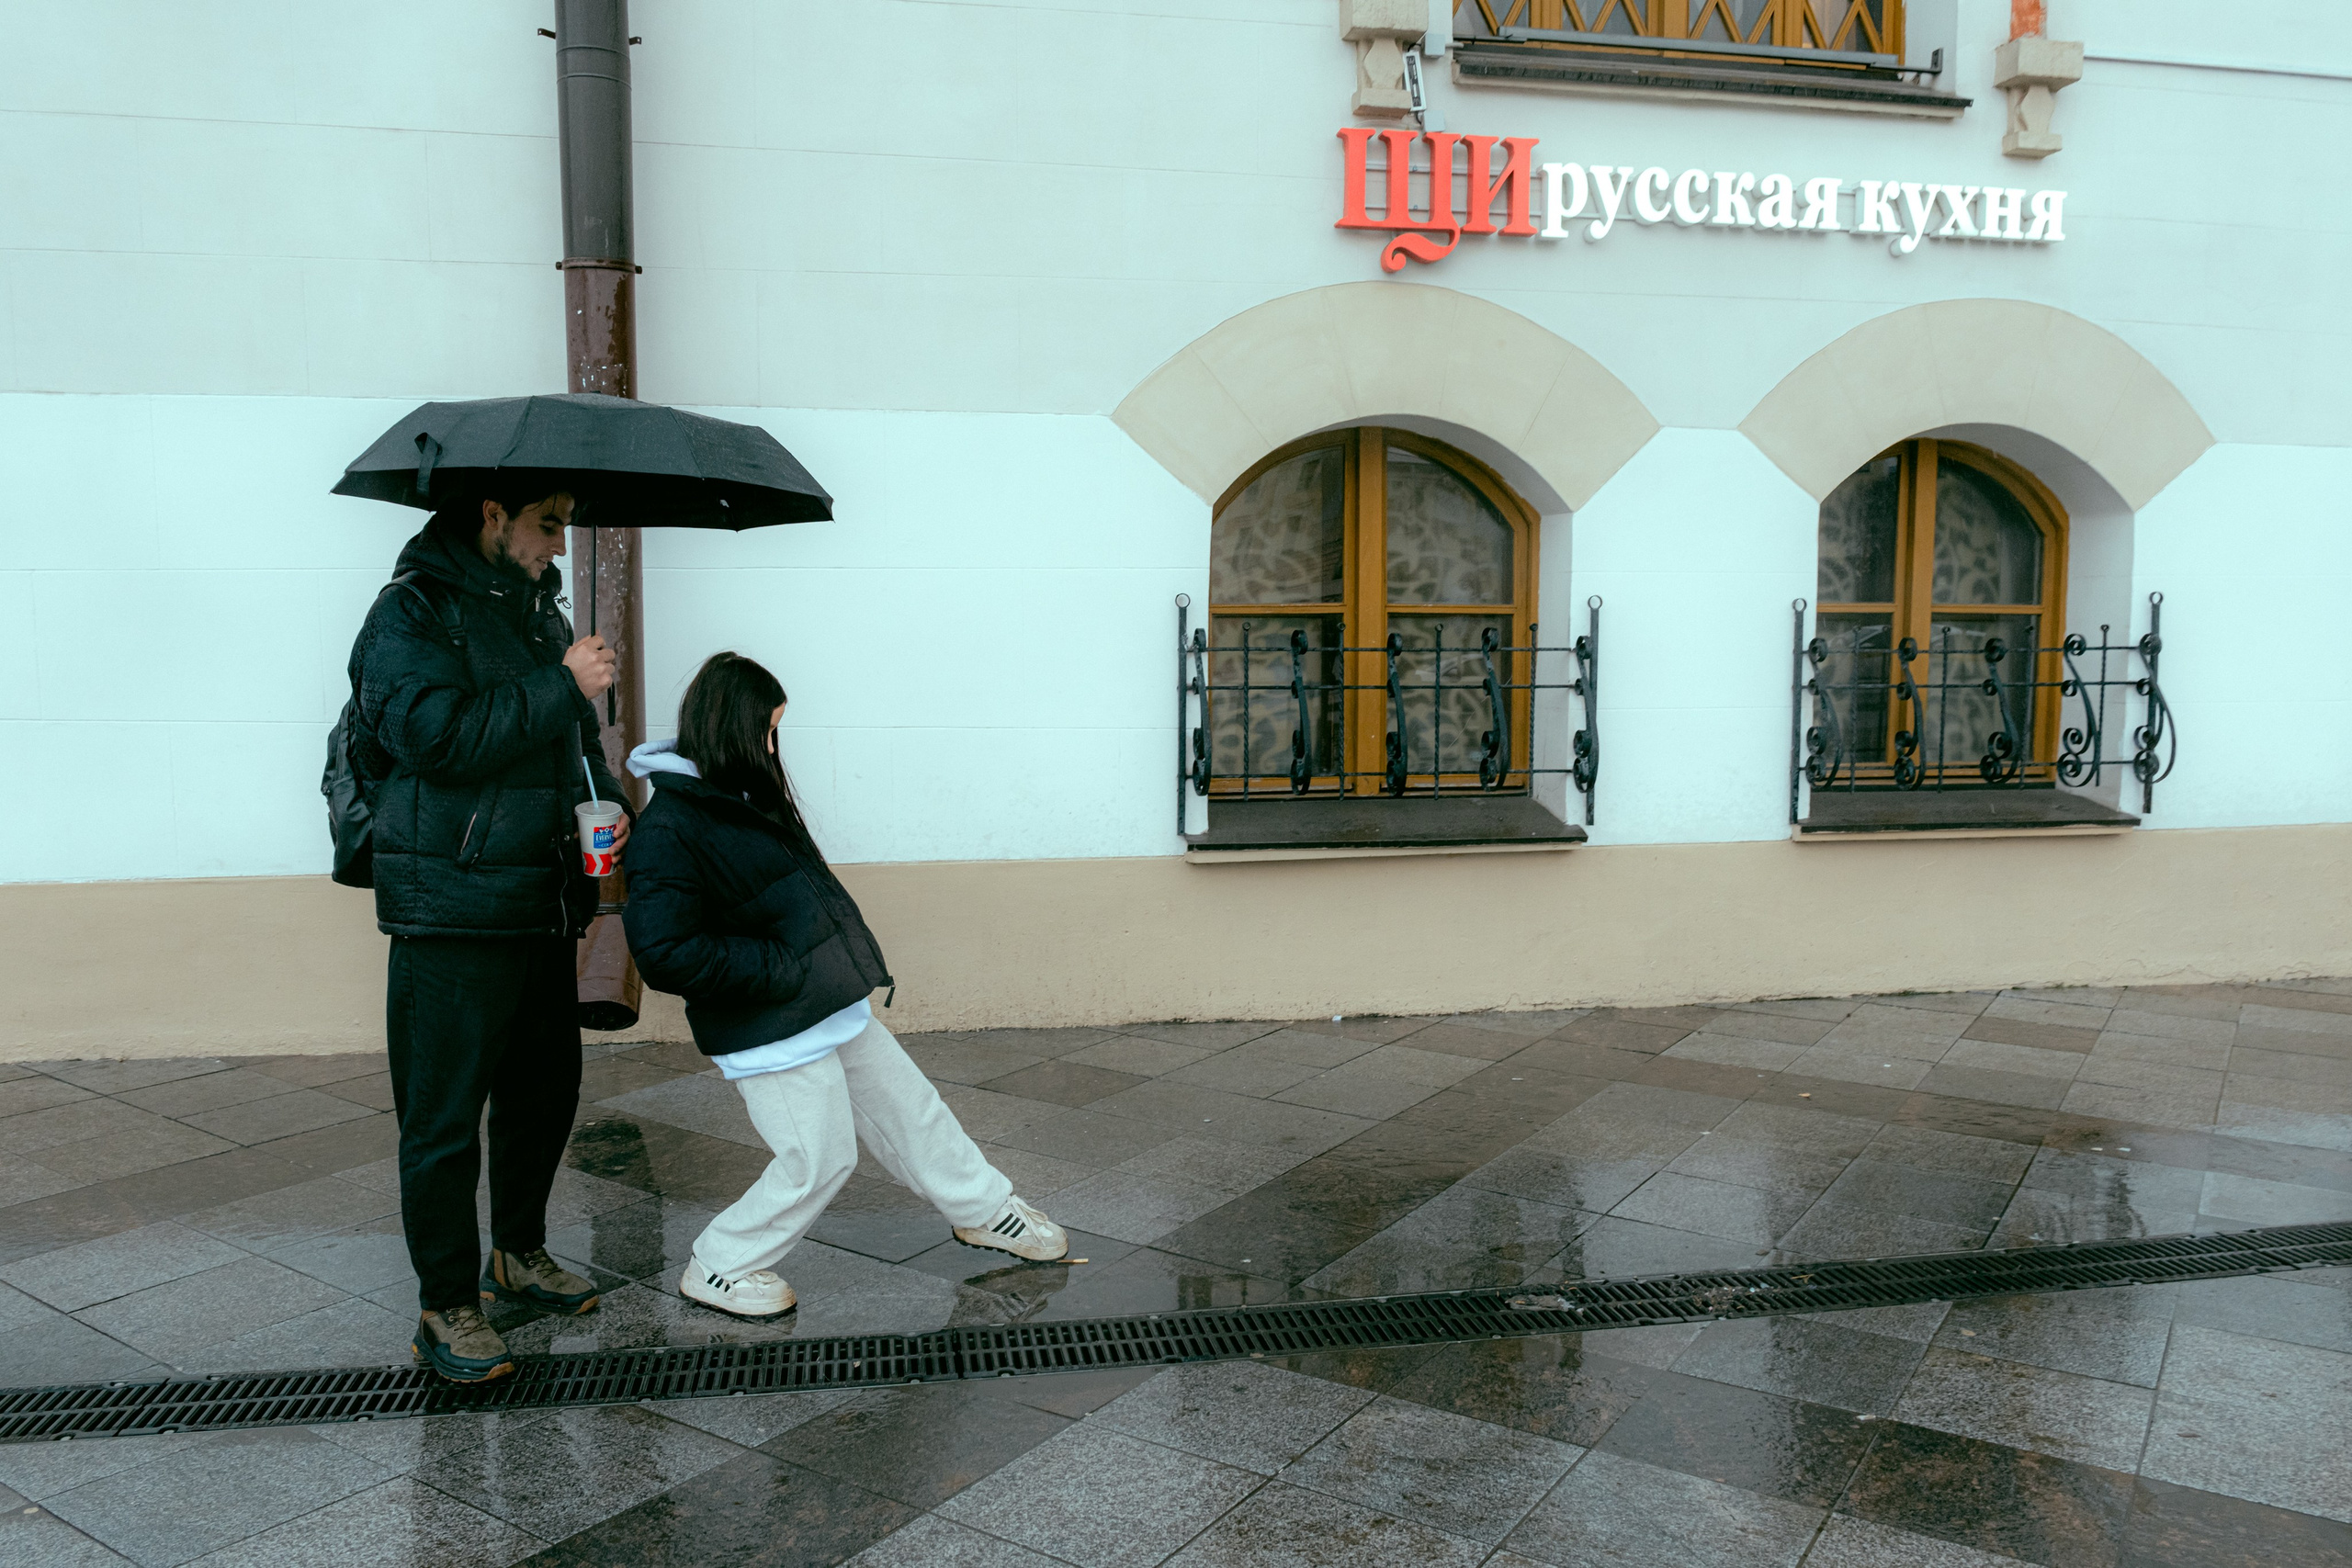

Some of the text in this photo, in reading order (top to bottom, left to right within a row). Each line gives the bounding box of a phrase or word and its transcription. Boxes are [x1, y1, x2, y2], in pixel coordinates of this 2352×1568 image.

[1334, 127, 2069, 274] ЩИ русская кухня
